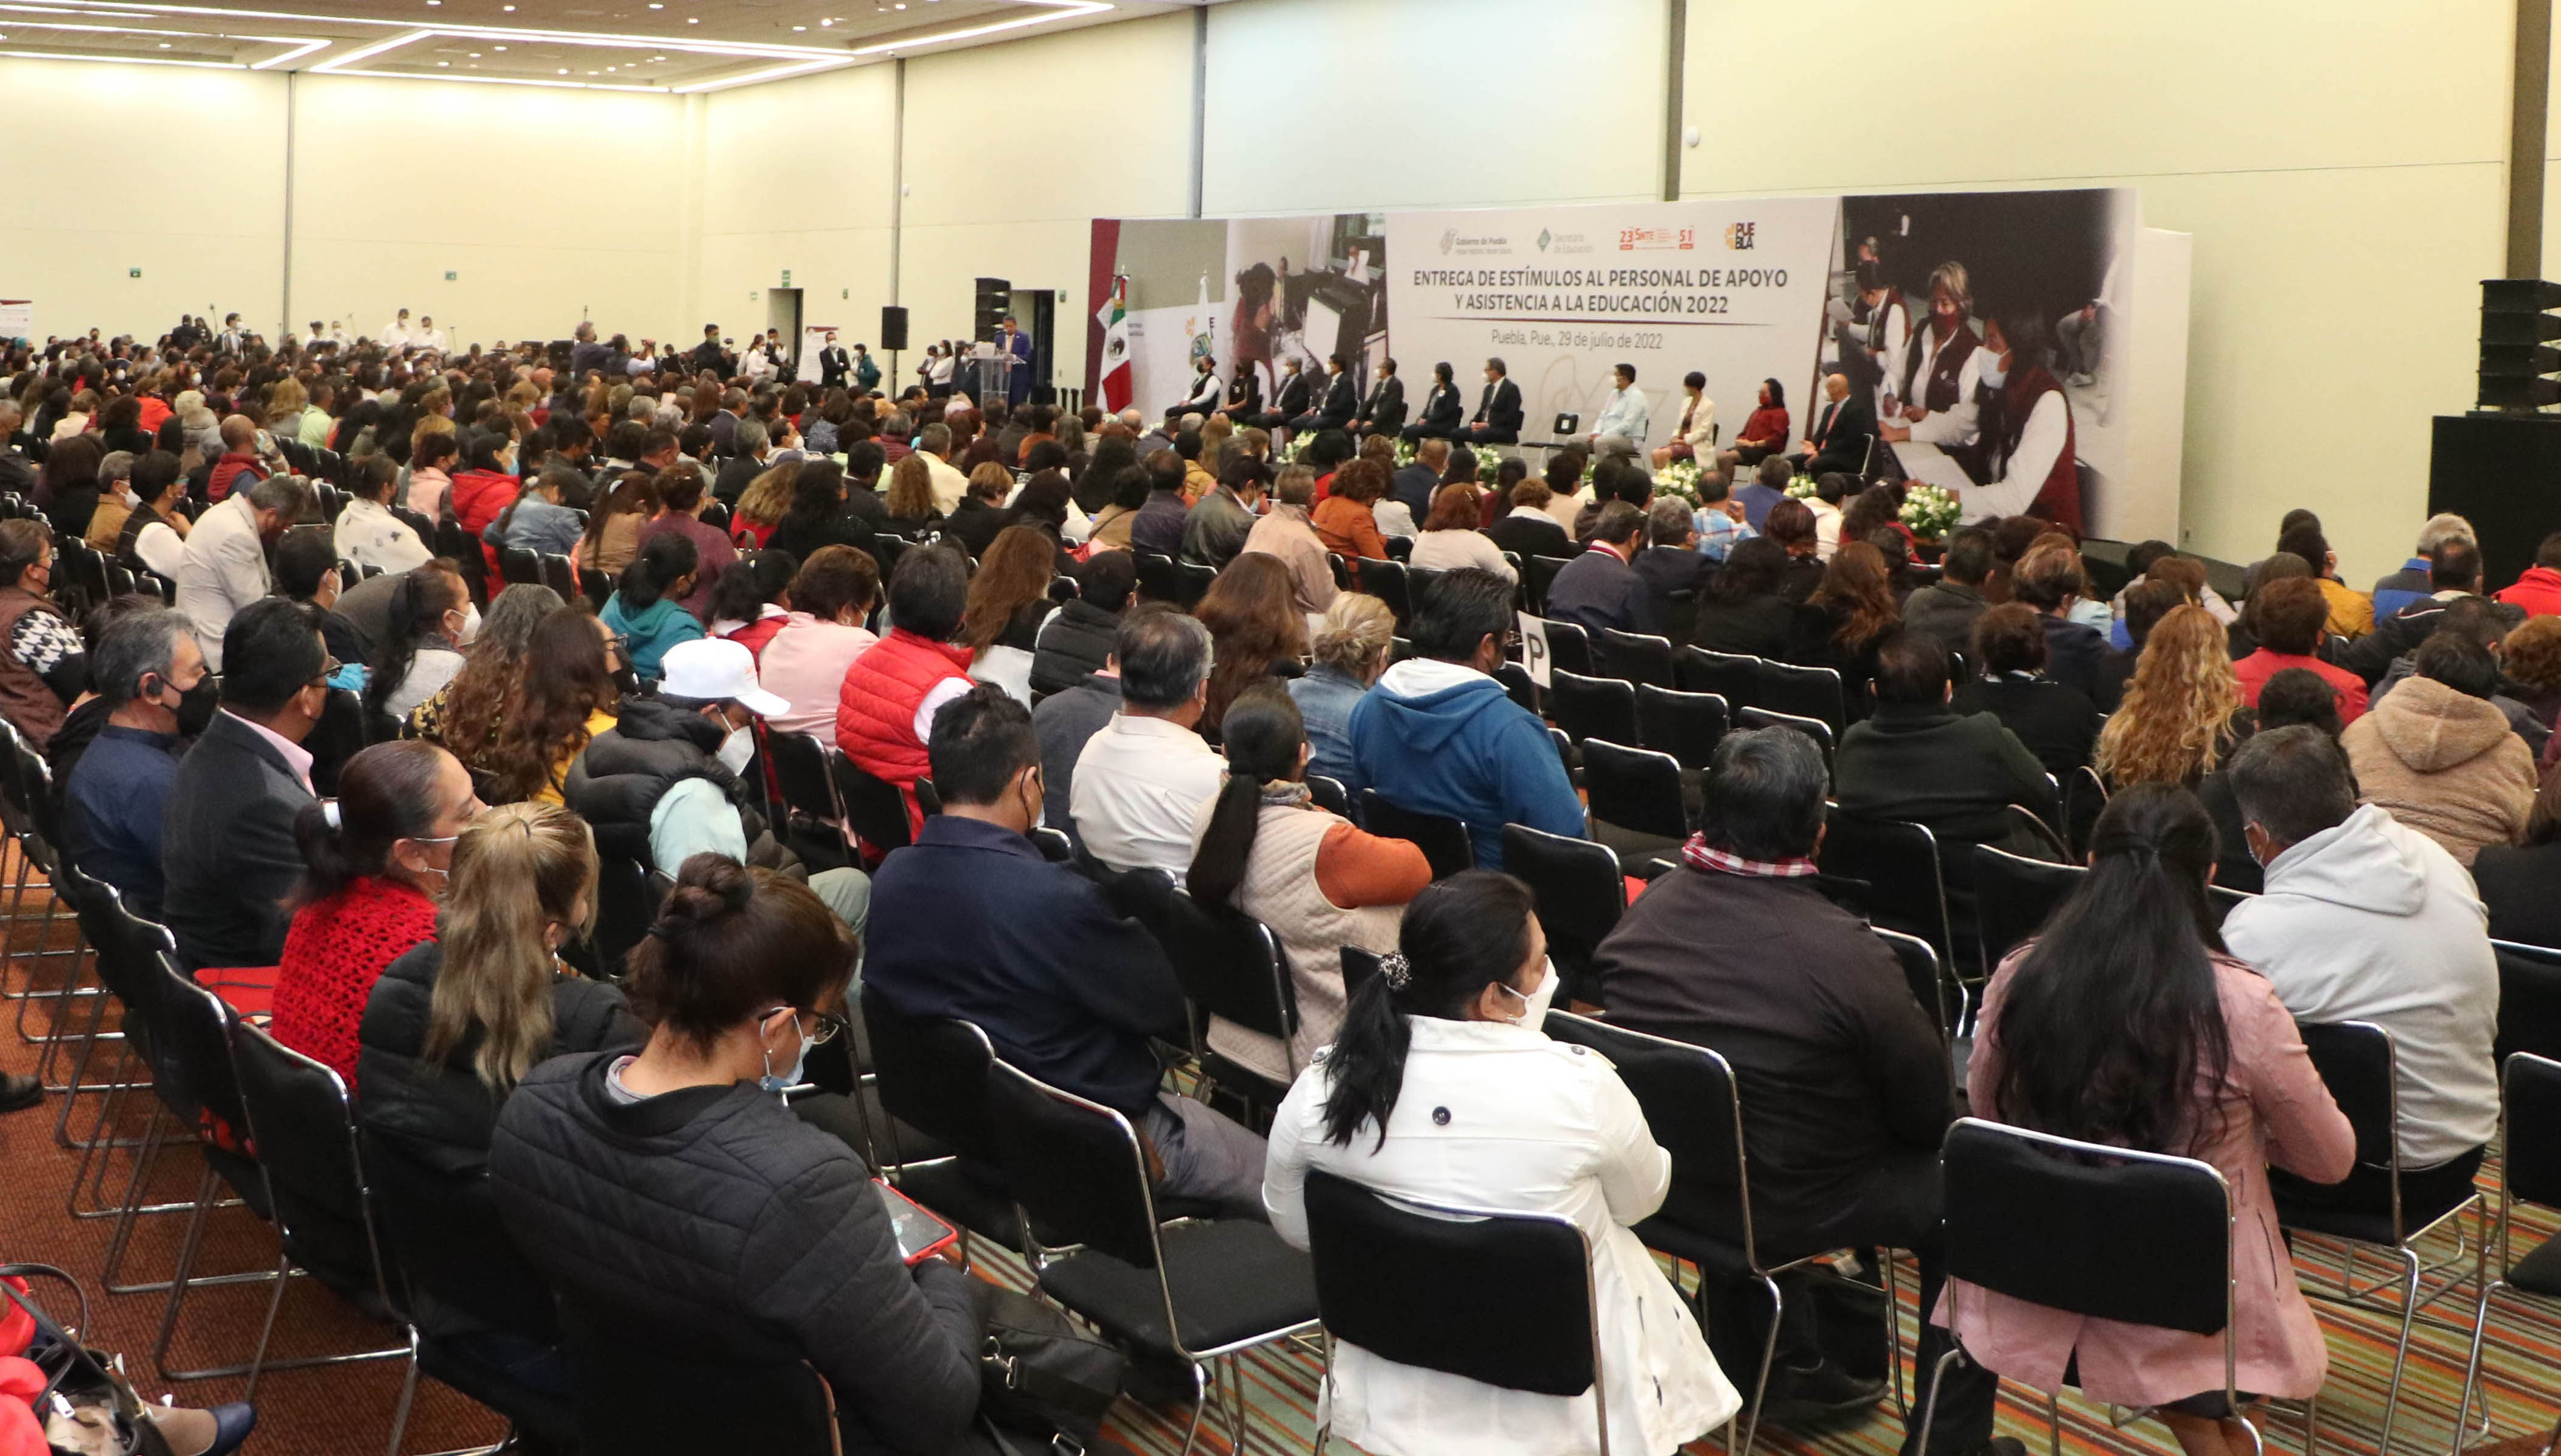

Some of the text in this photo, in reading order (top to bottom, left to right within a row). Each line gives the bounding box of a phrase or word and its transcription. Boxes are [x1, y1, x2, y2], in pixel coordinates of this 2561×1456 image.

[1620, 230, 1633, 243] 23
[1679, 229, 1693, 242] 51
[1413, 265, 1788, 287] ENTREGA DE ESTÍMULOS AL PERSONAL DE APOYO
[1455, 290, 1728, 313] Y ASISTENCIA A LA EDUCACIÓN 2022
[1491, 329, 1527, 346] Puebla,
[1558, 330, 1572, 346] 29
[1574, 331, 1588, 347] de
[1588, 332, 1614, 351] julio
[1617, 333, 1631, 348] de
[1634, 333, 1663, 349] 2022
[1527, 632, 1544, 673] P
